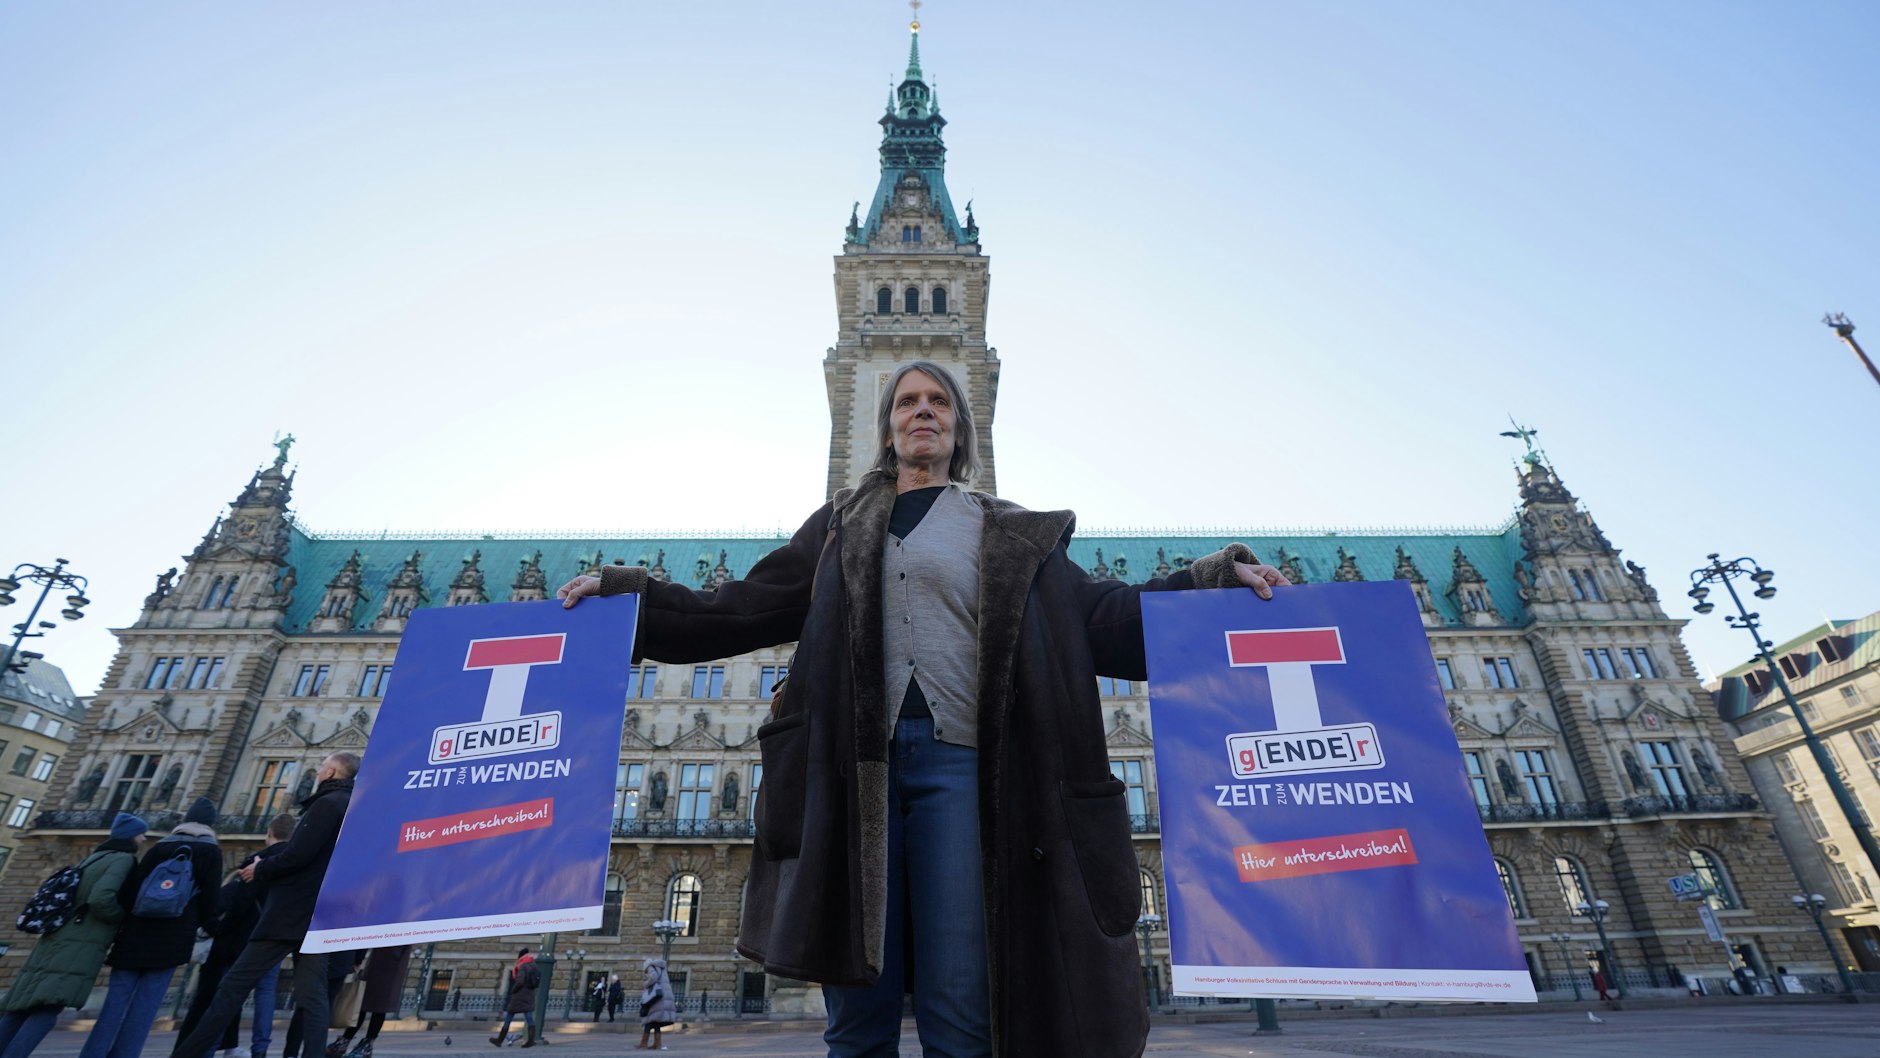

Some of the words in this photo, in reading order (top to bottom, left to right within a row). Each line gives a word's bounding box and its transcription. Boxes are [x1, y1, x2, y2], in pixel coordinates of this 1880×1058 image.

[439, 720, 552, 758] g[ENDE]r
[1239, 732, 1369, 772] g[ENDE]r
[403, 768, 456, 790] ZEIT
[456, 766, 468, 785] ZUM
[470, 758, 572, 784] WENDEN
[1214, 784, 1272, 806] ZEIT
[1275, 783, 1288, 805] ZUM
[1288, 781, 1414, 805] WENDEN
[405, 826, 436, 842] Hier
[442, 803, 548, 836] unterschreiben!
[1241, 852, 1276, 870] Hier
[1284, 835, 1407, 865] unterschreiben!
[323, 937, 350, 945] Hamburger
[412, 928, 449, 936] Gendersprache
[1194, 976, 1226, 984] Hamburger
[1298, 978, 1342, 986] Gendersprache
[1395, 980, 1418, 988] Bildung
